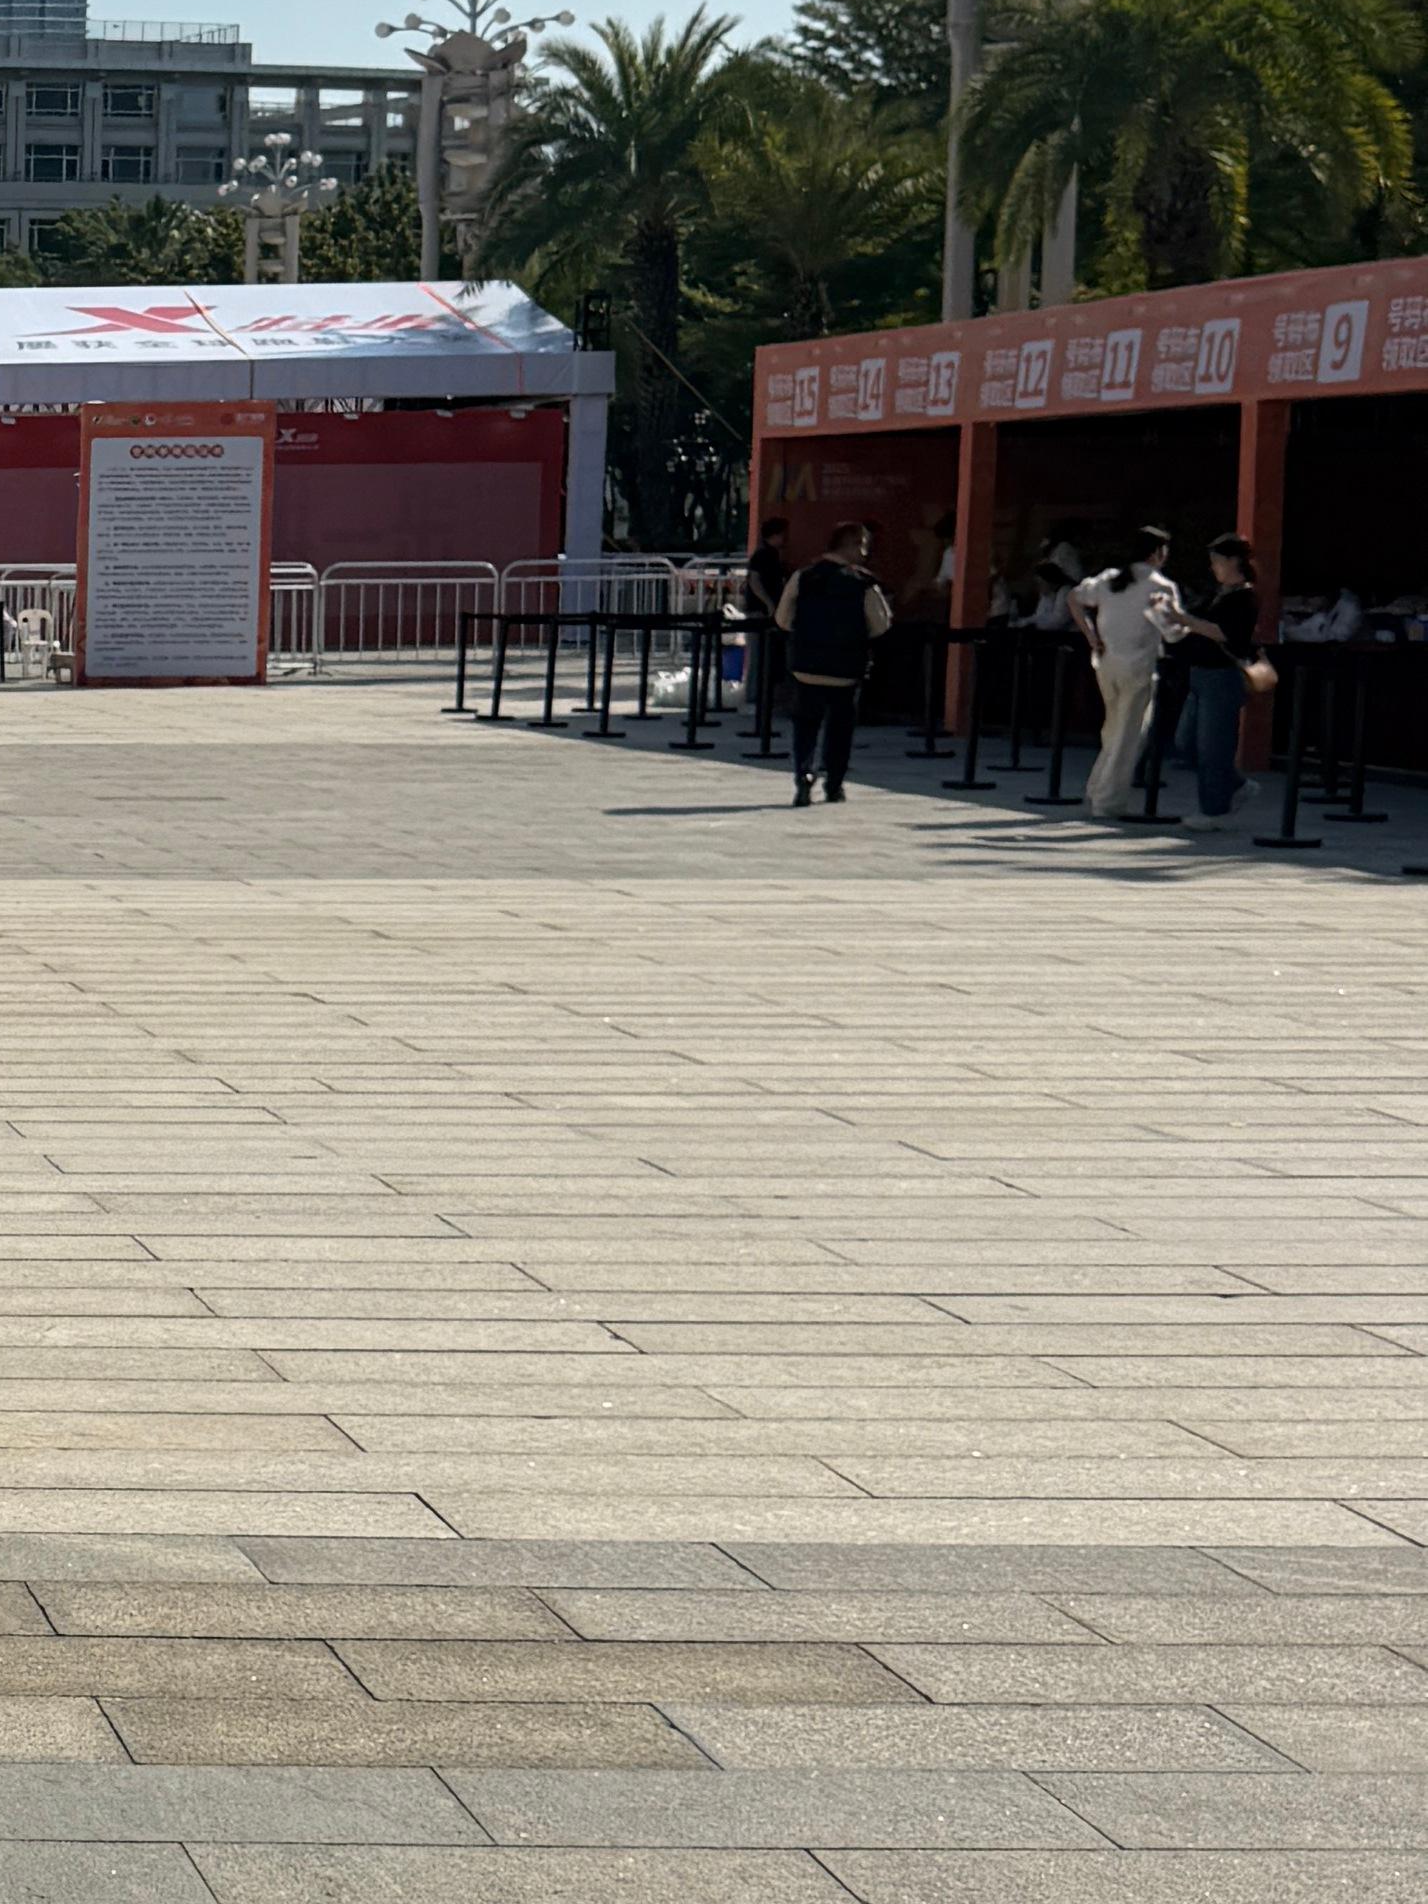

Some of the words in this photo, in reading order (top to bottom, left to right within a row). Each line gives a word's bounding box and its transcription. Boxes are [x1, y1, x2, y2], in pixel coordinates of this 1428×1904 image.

[1105, 340, 1134, 388] 11
[1200, 330, 1233, 382] 10
[1330, 313, 1352, 370] 9
[796, 376, 817, 416] 15
[860, 368, 881, 410] 14
[930, 361, 955, 405] 13
[1020, 351, 1046, 397] 12
